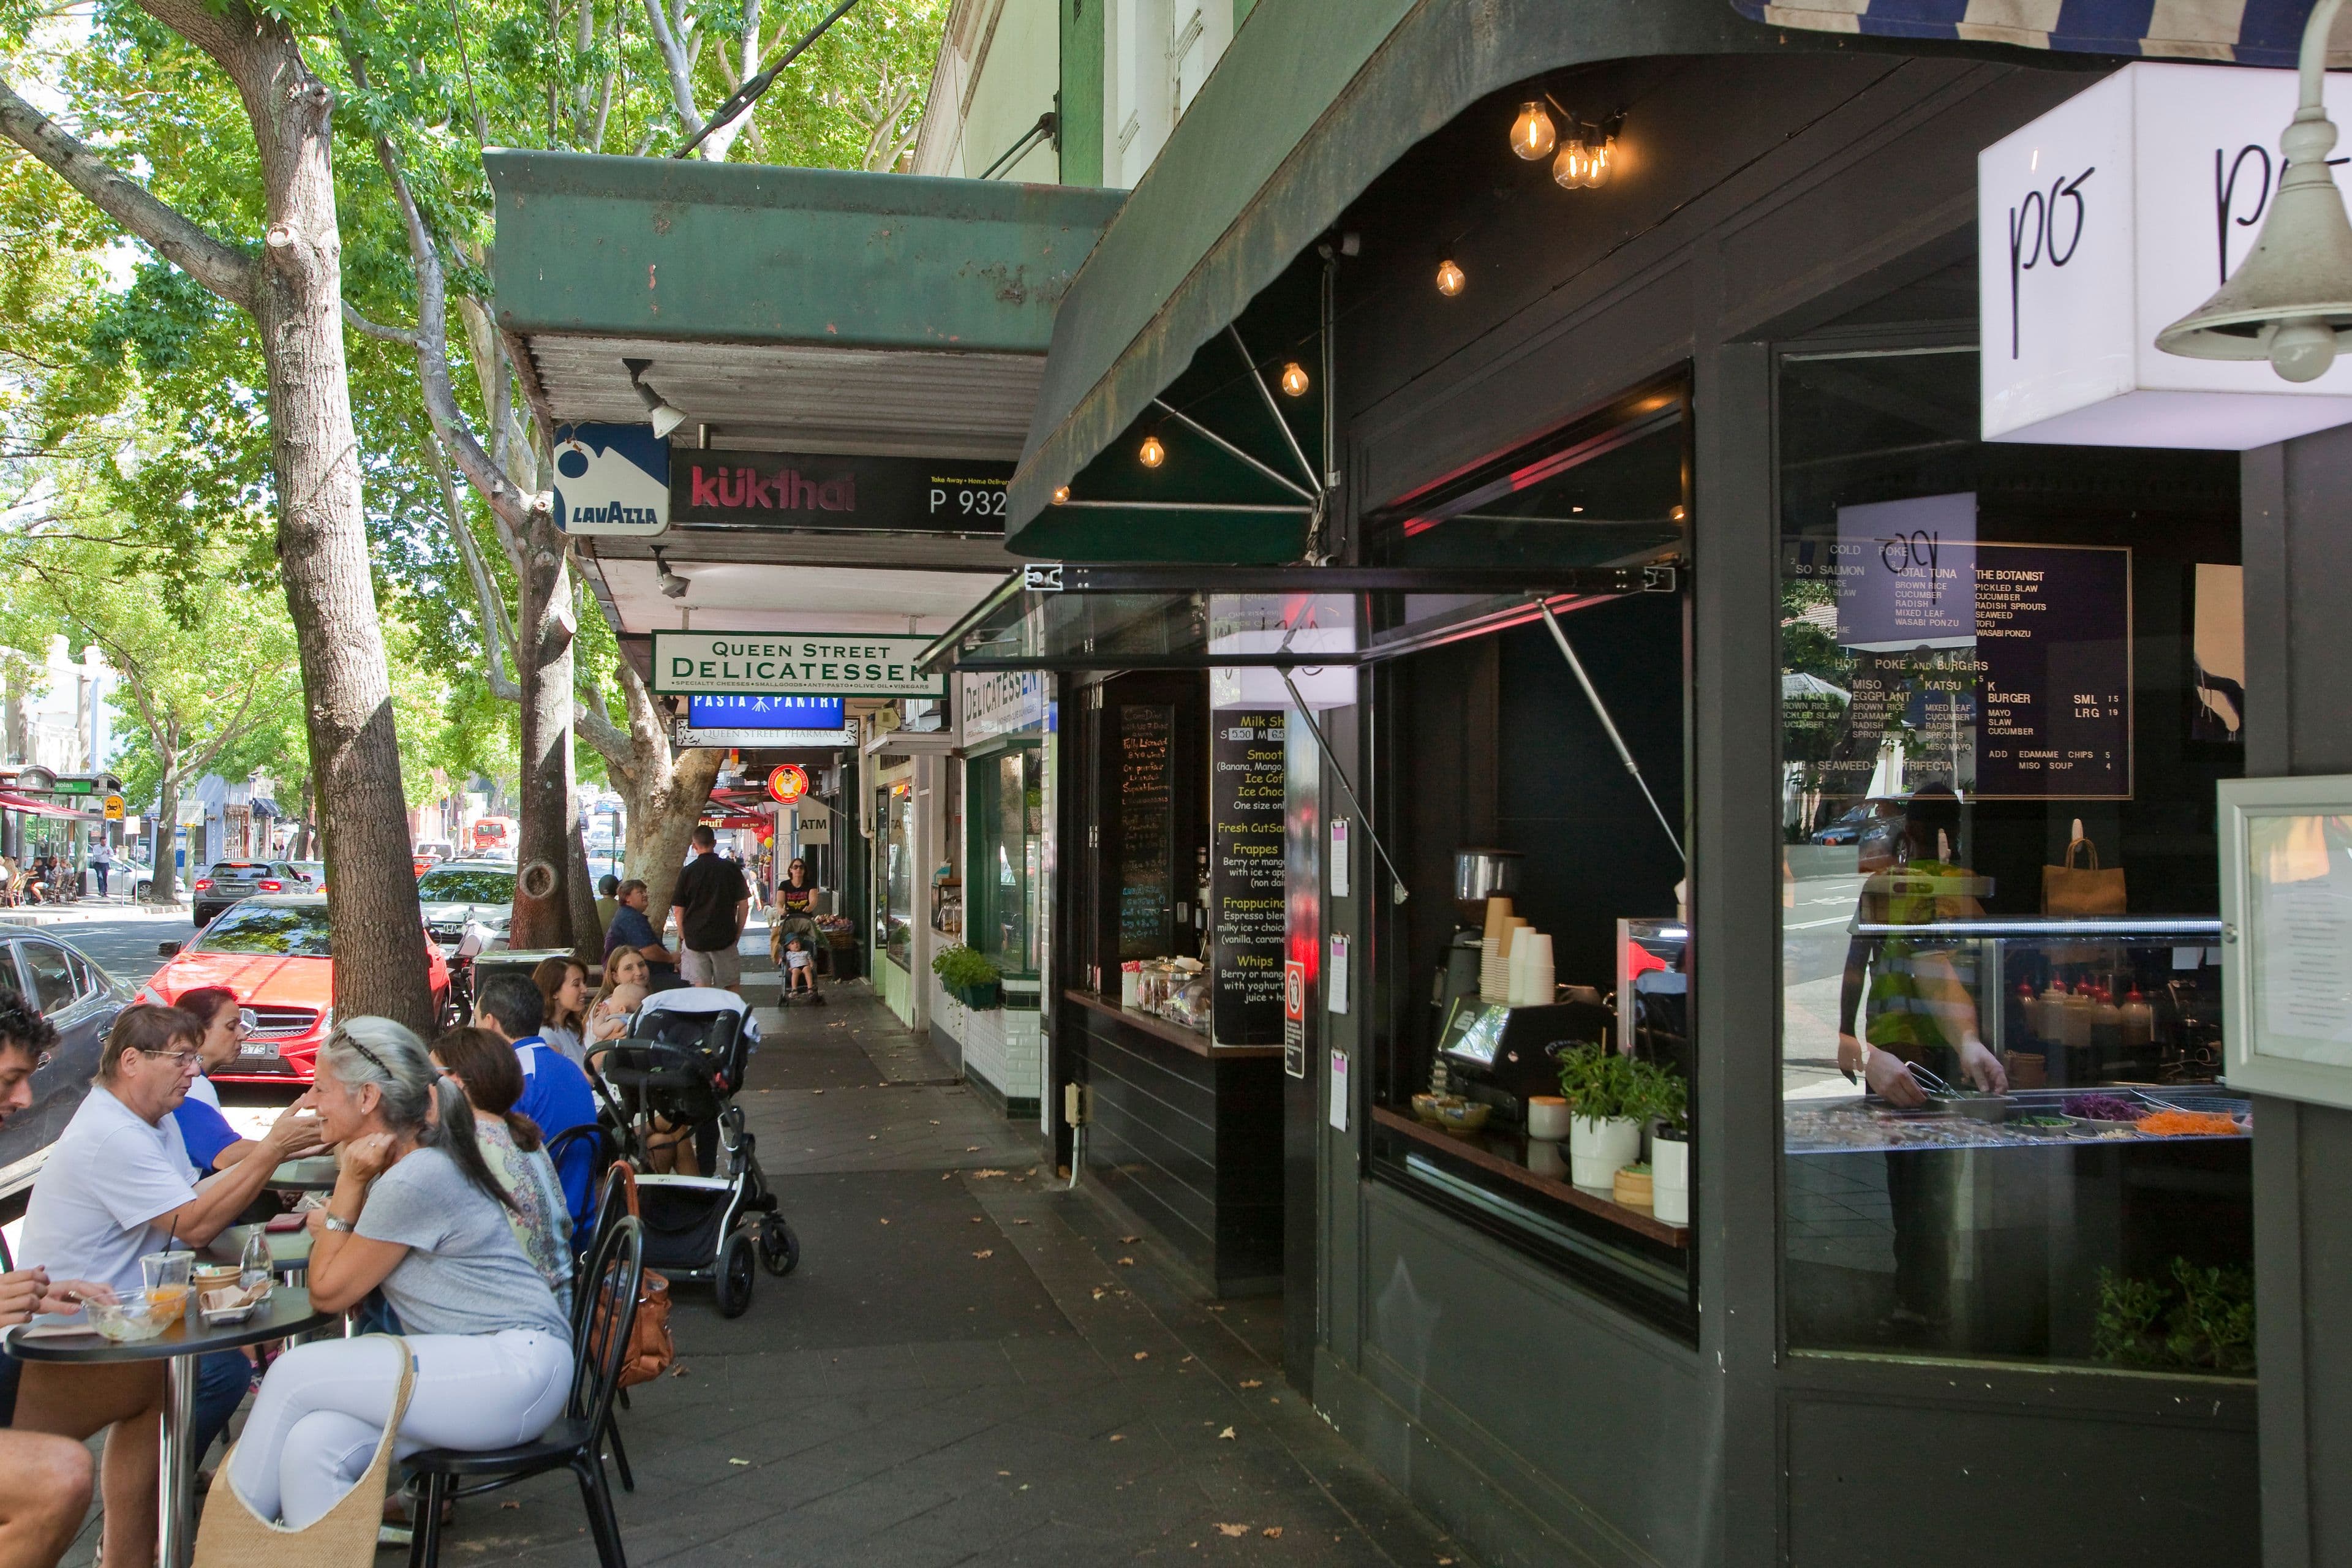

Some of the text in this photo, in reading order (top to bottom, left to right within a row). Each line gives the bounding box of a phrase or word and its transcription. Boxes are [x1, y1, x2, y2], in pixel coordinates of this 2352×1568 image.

[2216, 145, 2351, 287] p
[930, 489, 1007, 516] P 932
[572, 501, 658, 524] LAVAZZA
[1830, 545, 1908, 556] COLD POKE
[1796, 565, 1864, 576] SO SALMON
[1896, 567, 1957, 579] TOTAL TUNA
[1975, 570, 2045, 581] THE BOTANIST
[1833, 589, 1856, 597] SLAW
[1975, 583, 2011, 592] PICKLED
[1895, 590, 1942, 599] CUCUMBER
[1975, 601, 2007, 610] RADISH
[1975, 611, 2013, 619] SEAWEED
[1929, 619, 1959, 627] PONZU
[1976, 628, 2004, 637] WASABI
[712, 641, 891, 658] QUEEN STREET
[671, 657, 929, 682] DELICATESSEN
[1835, 658, 1859, 668] HOT
[1875, 659, 1907, 669] POKE
[1913, 662, 1931, 671] AND
[1852, 679, 1882, 690] MISO
[1924, 680, 1962, 691] KATSU
[1988, 681, 1996, 692] K
[694, 696, 839, 708] PASTA PANTRY
[966, 671, 1037, 722] DELICATESSEN
[1852, 692, 1912, 702] EGGPLANT
[1988, 693, 2030, 704] BURGER
[2073, 695, 2098, 705] SML
[2075, 708, 2100, 718] LRG
[1240, 715, 1284, 727] Milk Sh
[703, 729, 842, 739] QUEEN STREET PHARMACY
[1220, 730, 1227, 739] S
[1232, 729, 1251, 739] 5.50
[1257, 730, 1267, 739] M
[1247, 749, 1284, 760] Smoot
[1217, 761, 1253, 772] (Banana,
[1817, 761, 1871, 771] SEAWEED
[1903, 761, 1953, 771] TRIFECTA
[1245, 773, 1284, 783] Ice Cof
[1238, 786, 1256, 796] Ice
[1234, 801, 1251, 810] One
[1253, 801, 1270, 810] size
[800, 819, 827, 830] ATM
[1218, 823, 1248, 833] Fresh
[1234, 843, 1278, 858] Frappes
[1223, 857, 1248, 869] Berry
[1229, 868, 1248, 876] with
[1251, 868, 1263, 876] ice
[1251, 878, 1269, 889] (non
[1224, 911, 1264, 922] Espresso
[1217, 922, 1238, 934] milky
[1241, 923, 1253, 932] ice
[1221, 935, 1254, 945] (vanilla,
[1237, 956, 1273, 970] Whips
[1221, 969, 1246, 981] Berry
[1261, 971, 1285, 981] mang
[1224, 981, 1284, 992] with yoghurt
[1244, 993, 1267, 1005] juice
